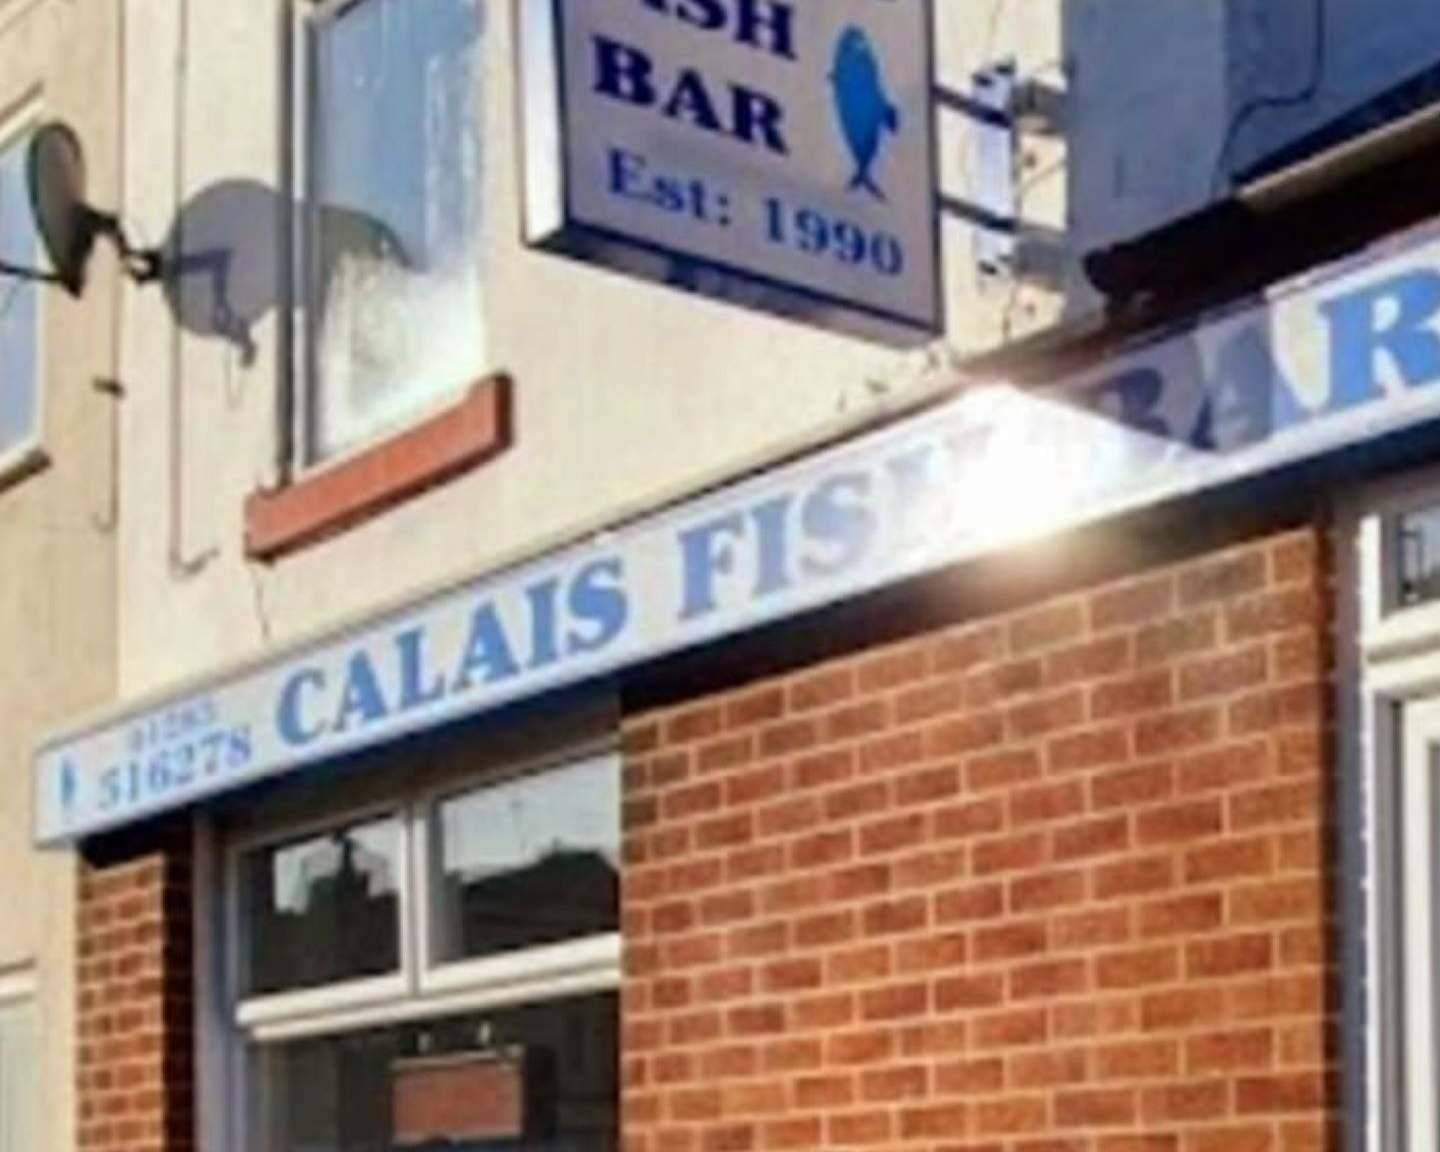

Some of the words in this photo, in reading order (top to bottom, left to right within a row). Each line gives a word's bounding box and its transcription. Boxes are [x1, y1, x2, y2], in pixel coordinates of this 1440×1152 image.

[591, 35, 790, 156] BAR
[606, 147, 730, 227] Est:
[764, 196, 903, 277] 1990
[275, 555, 629, 747] CALAIS
